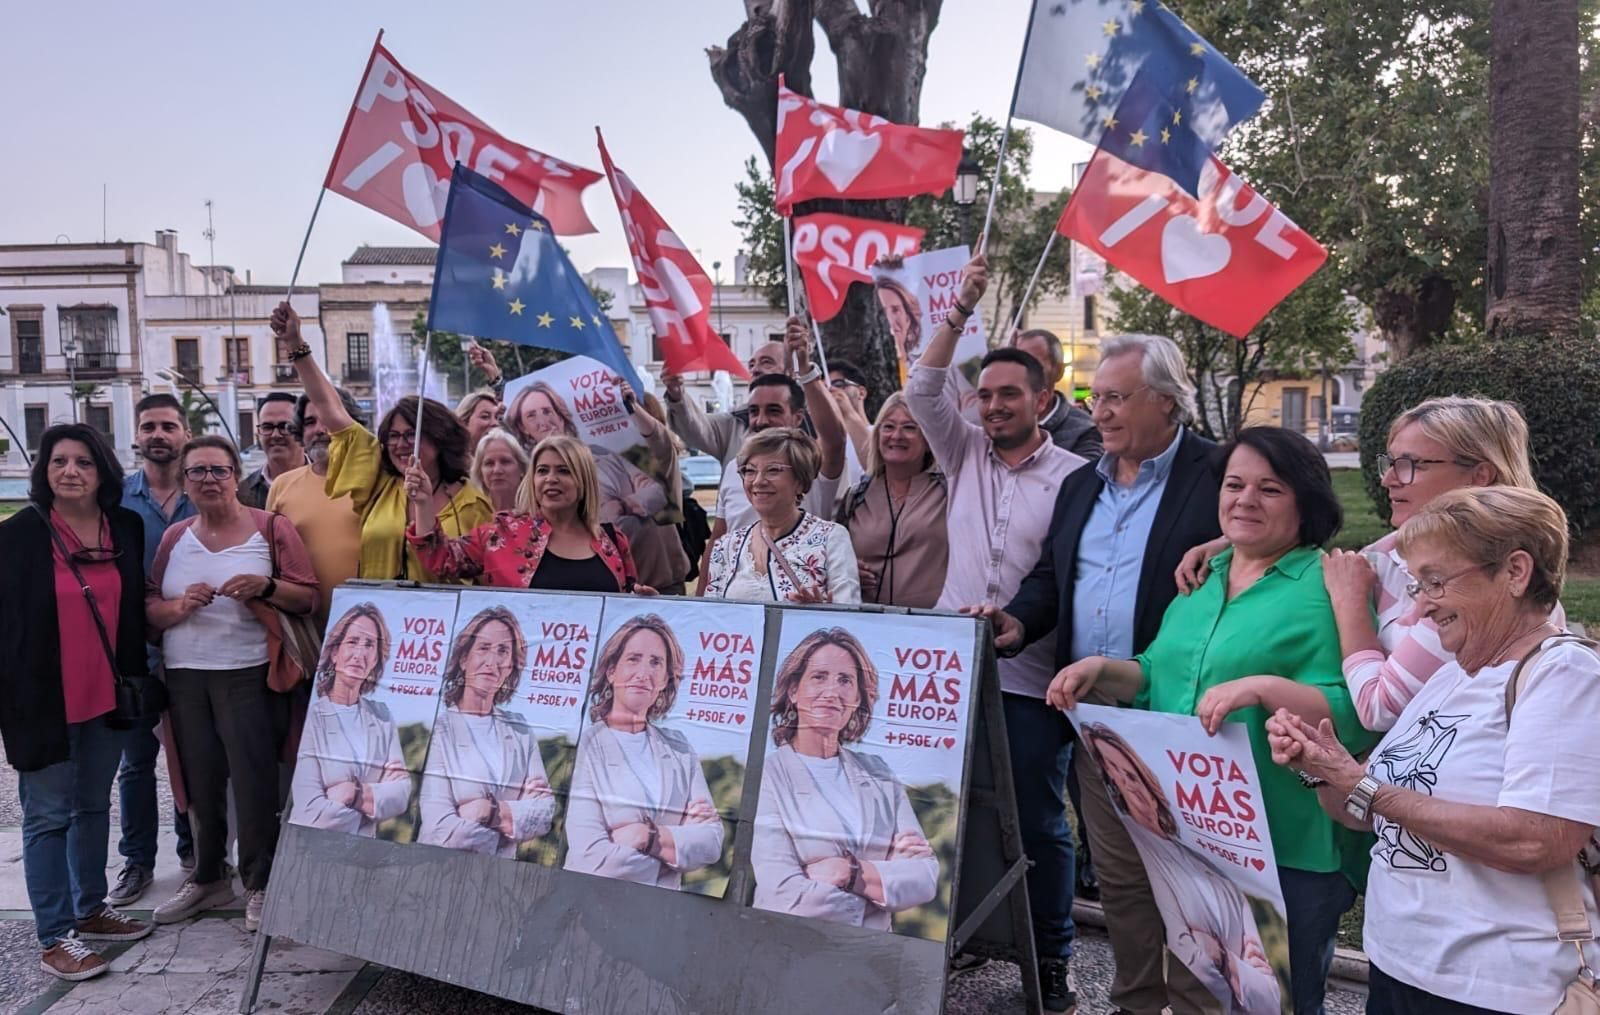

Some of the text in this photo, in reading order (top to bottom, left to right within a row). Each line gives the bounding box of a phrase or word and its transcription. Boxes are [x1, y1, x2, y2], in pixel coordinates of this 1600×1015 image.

[929, 286, 961, 312] MÁ
[570, 369, 611, 390] VOTA
[574, 386, 616, 413] MÁS
[579, 405, 622, 422] EUROPA
[404, 617, 445, 636] VOTA
[541, 622, 589, 642] VOTA
[396, 636, 443, 662] MÁS
[699, 632, 755, 655] VOTA
[393, 661, 438, 676] EUROPA
[534, 643, 587, 670] MÁS
[894, 648, 963, 672] VOTA
[531, 670, 582, 685] EUROPA
[692, 654, 753, 685] MÁS
[690, 683, 749, 700] EUROPA
[889, 671, 961, 705] MÁS
[887, 703, 958, 723] EUROPA
[1166, 750, 1249, 784] VOTA
[1175, 781, 1257, 821] MÁS
[1181, 812, 1261, 842] EUROPA
